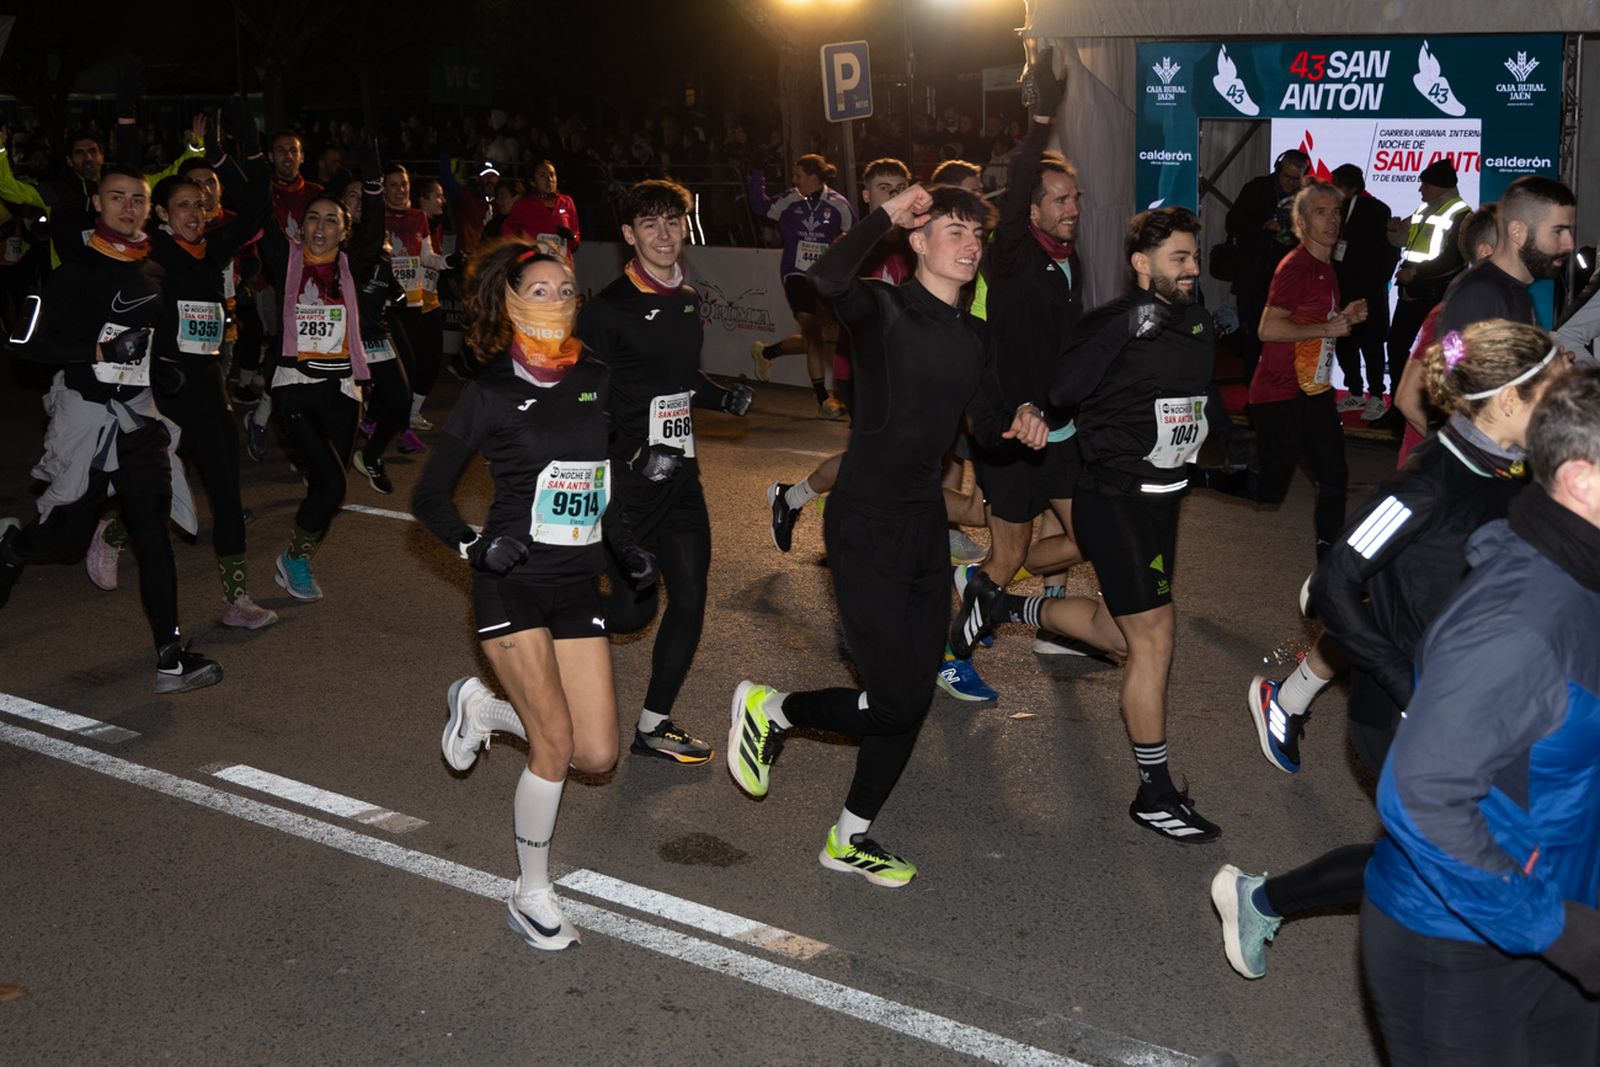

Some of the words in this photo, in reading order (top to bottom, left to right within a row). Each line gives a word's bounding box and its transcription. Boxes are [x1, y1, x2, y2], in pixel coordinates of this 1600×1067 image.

[1289, 50, 1327, 80] 43
[1327, 50, 1391, 78] SAN
[833, 52, 861, 112] P
[1496, 83, 1516, 92] CAJA
[1517, 83, 1546, 92] RURAL
[1227, 84, 1245, 104] 43
[1279, 75, 1385, 111] ANTÓN
[1428, 83, 1449, 104] 43
[1379, 129, 1414, 138] CARRERA
[1415, 129, 1447, 138] URBANA
[1377, 139, 1411, 150] NOCHE
[1412, 140, 1426, 150] DE
[1139, 150, 1193, 162] calderón
[1373, 150, 1424, 172] SAN
[1485, 156, 1551, 168] calderón
[1371, 174, 1380, 182] 17
[1380, 174, 1390, 182] DE
[1391, 174, 1417, 183] ENERO
[188, 320, 219, 337] 9355
[299, 321, 336, 337] 2837
[663, 416, 691, 439] 668
[1170, 423, 1199, 446] 1041
[559, 471, 584, 480] NOCHE
[547, 480, 566, 490] SAN
[552, 491, 600, 517] 9514
